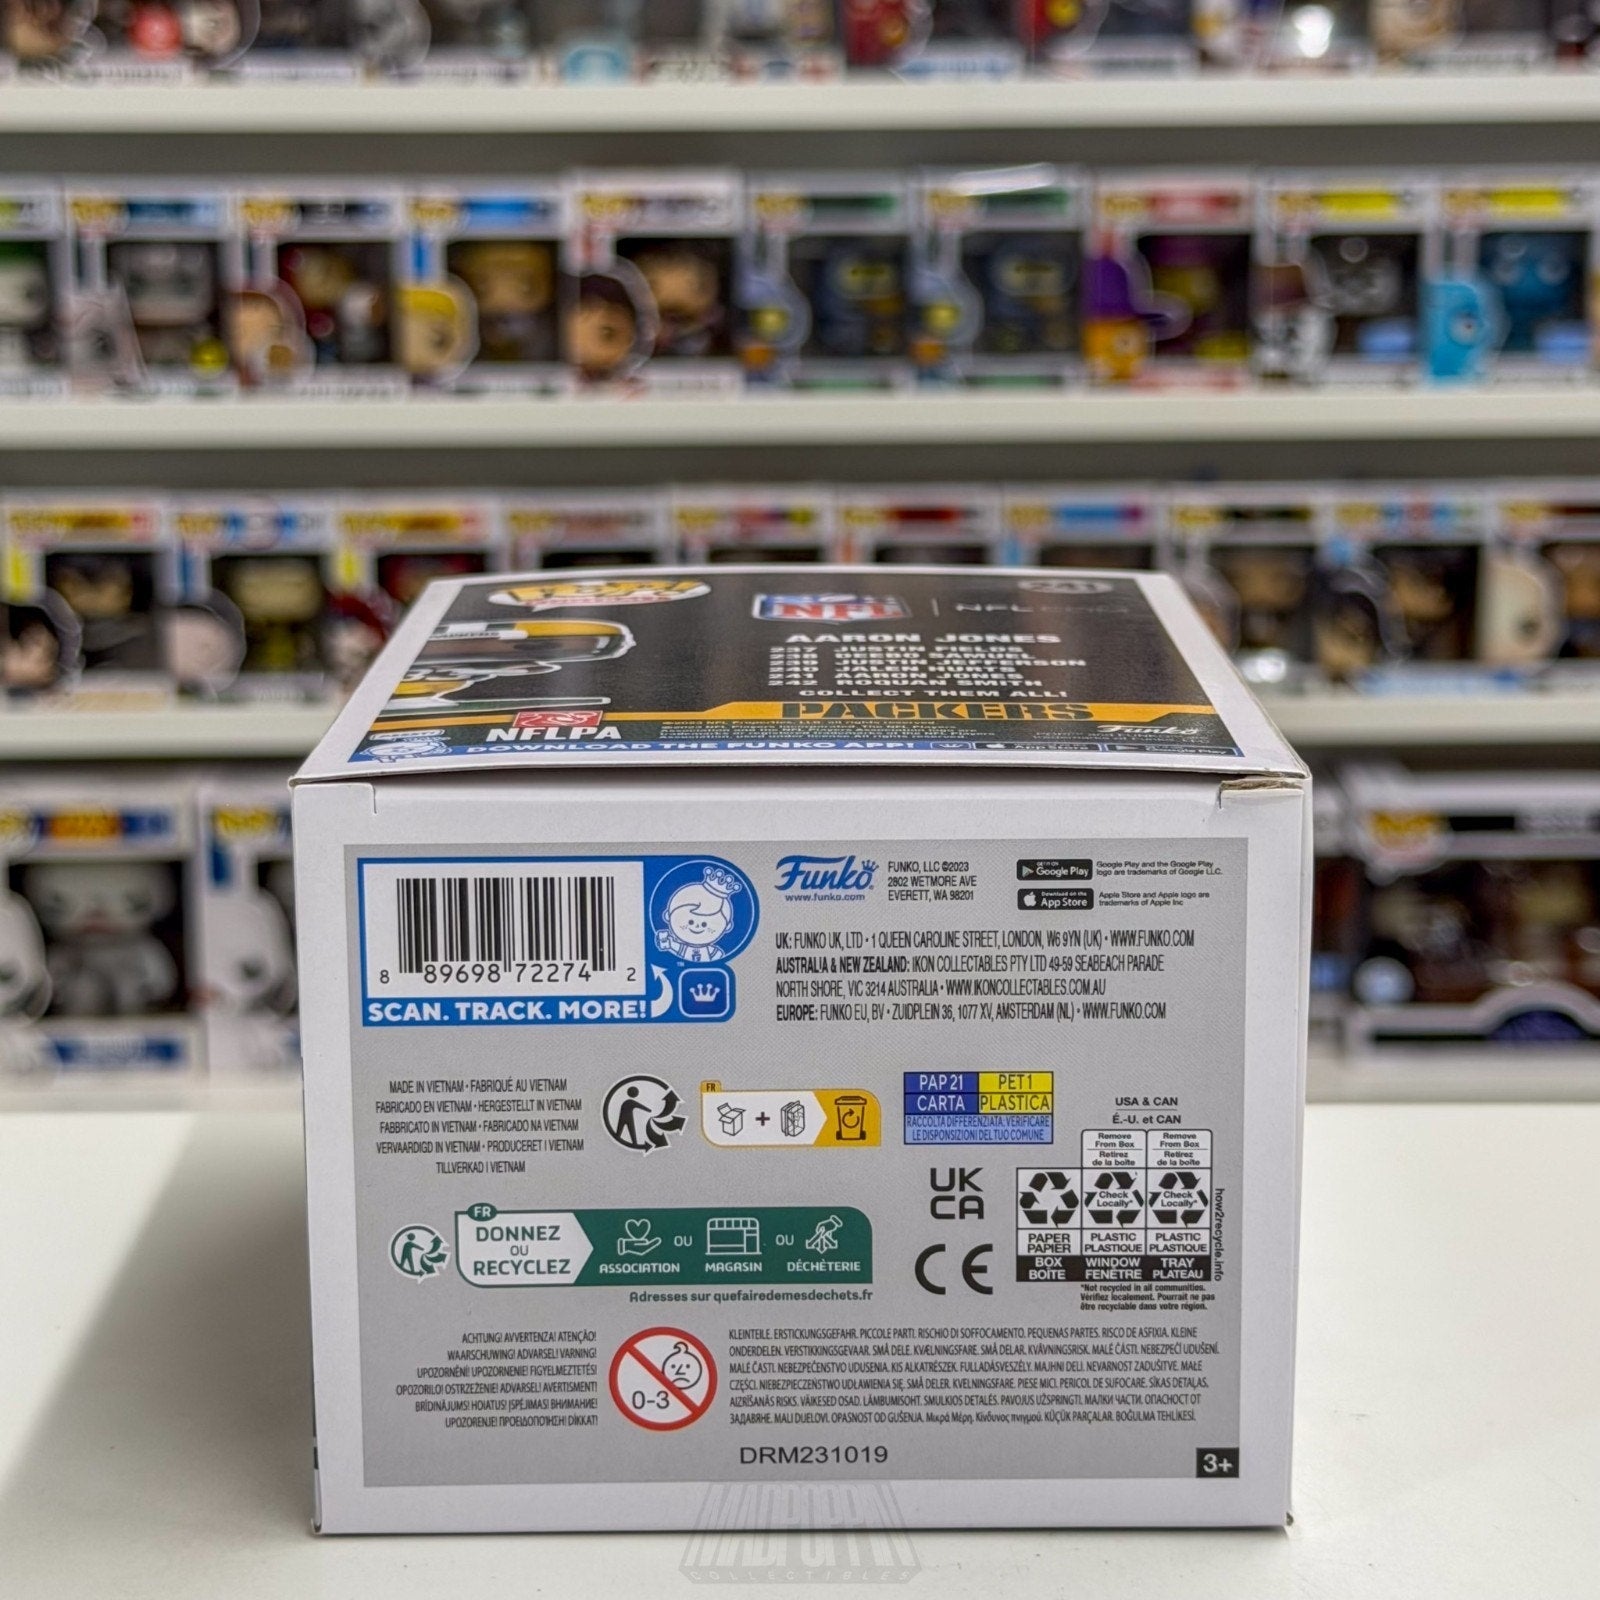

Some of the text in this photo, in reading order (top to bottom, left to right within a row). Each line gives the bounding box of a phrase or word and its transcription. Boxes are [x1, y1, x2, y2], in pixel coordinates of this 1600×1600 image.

[782, 603, 899, 619] NFL
[786, 634, 1061, 643] AARON JONES
[782, 703, 1094, 719] PACKERS
[486, 727, 621, 741] NFLPA
[466, 743, 652, 753] DOWNLOAD
[659, 742, 718, 750] THE
[774, 855, 876, 890] Funko
[888, 861, 969, 874] FUNKO, LLC ©2023
[1036, 867, 1089, 878] Google Play
[888, 876, 977, 887] 2802 WETMORE AVE
[785, 893, 865, 902] www.funko.com
[888, 890, 974, 902] EVERETT, WA 98201
[1041, 898, 1088, 908] App Store
[776, 930, 1194, 950] UK: FUNKO UK, LTD 1 QUEEN CAROLINE STREET, LONDON, W6 9YN (UK) WWW.FUNKO.COM
[776, 954, 1164, 973] AUSTRALIA & NEW ZEALAND: IKON COLLECTABLES PTY LTD 49-59 SEABEACH PARADE
[379, 962, 637, 985] 8 89698 72274 2
[776, 979, 1106, 999] NORTH SHORE, VIC 3214 AUSTRALIA WWW.IKONCOLLECTABLES.COM.AU
[368, 999, 647, 1022] SCAN. TRACK. MORE!
[776, 1002, 1166, 1023] EUROPE: FUNKO EU, BV ZUIDPLEIN 36, 1077 XV, AMSTERDAM (NL) WWW.FUNKO.COM
[389, 1076, 567, 1093] MADE IN VIETNAM FABRIQUÉ AU VIETNAM
[705, 1083, 716, 1092] FR
[919, 1075, 963, 1091] PAP 21
[917, 1094, 966, 1112] CARTA
[980, 1094, 1050, 1111] PLASTICA
[1115, 1097, 1178, 1107] USA & CAN
[1112, 1113, 1182, 1124] É.-U. et CAN
[930, 1167, 983, 1192] UK
[473, 1206, 491, 1219] FR
[930, 1195, 984, 1220] CA
[475, 1225, 562, 1242] DONNEZ
[1028, 1234, 1070, 1243] PAPER
[1091, 1233, 1136, 1241] PLASTIC
[1155, 1233, 1201, 1241] PLASTIC
[1213, 1188, 1225, 1282] how2recycle.info
[674, 1236, 693, 1247] OU
[775, 1235, 795, 1246] OU
[510, 1245, 529, 1257] OU
[1027, 1243, 1071, 1253] PAPIER
[1084, 1244, 1143, 1253] PLASTIQUE
[1150, 1244, 1207, 1253] PLASTIQUE
[473, 1259, 571, 1276] RECYCLEZ
[705, 1261, 762, 1273] MAGASIN
[787, 1258, 861, 1272] DÉCHÈTERIE
[1035, 1257, 1062, 1267] BOX
[1086, 1257, 1140, 1268] WINDOW
[1161, 1257, 1195, 1268] TRAY
[599, 1263, 680, 1274] ASSOCIATION
[915, 1243, 993, 1294] CE
[1028, 1268, 1066, 1280] BOÎTE
[1085, 1268, 1142, 1280] FENÊTRE
[1153, 1269, 1204, 1279] PLATEAU
[629, 1289, 873, 1305] Adresses sur quefairedemesdechets.fr
[631, 1391, 670, 1410] 0-3
[739, 1446, 889, 1465] DRM231019
[1203, 1453, 1233, 1474] 3+
